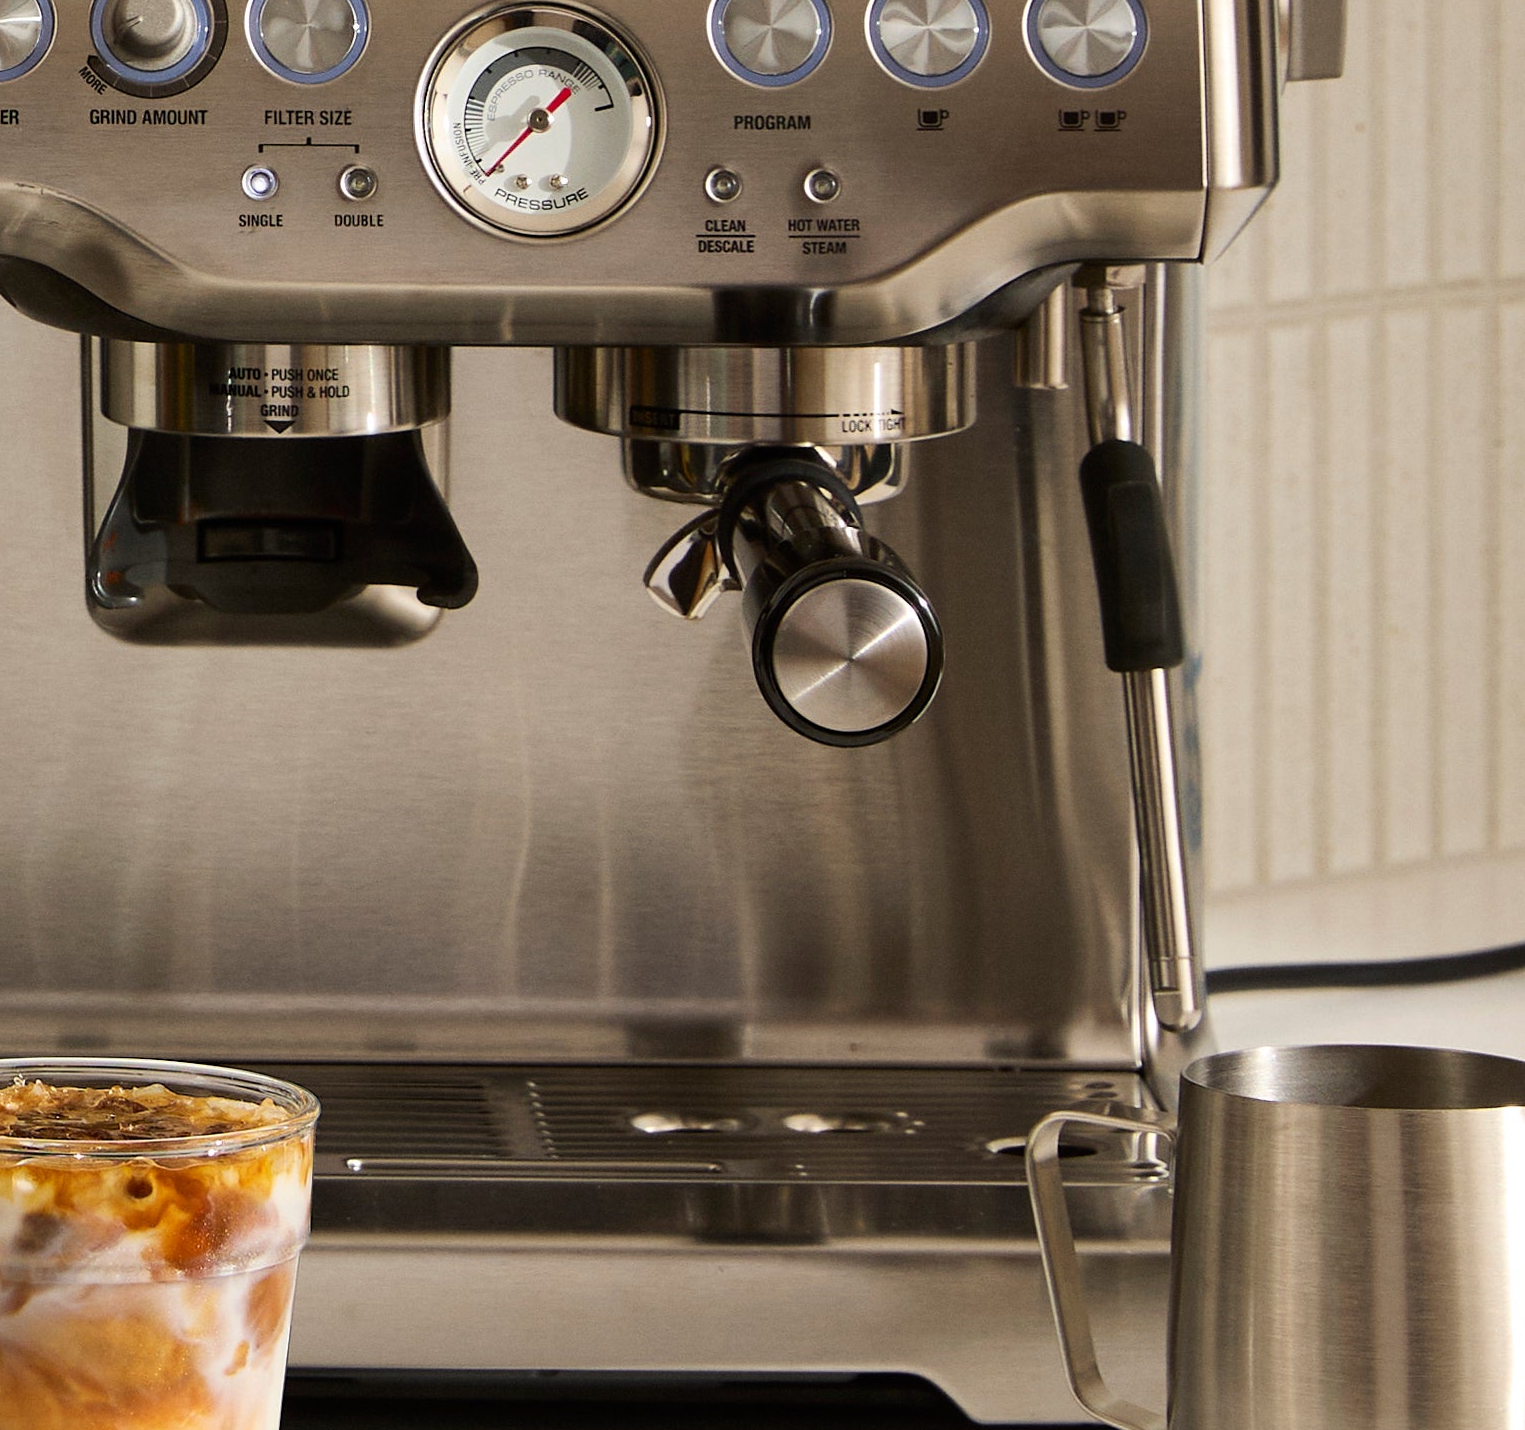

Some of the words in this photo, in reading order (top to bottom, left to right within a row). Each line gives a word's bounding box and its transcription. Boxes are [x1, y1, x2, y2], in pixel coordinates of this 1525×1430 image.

[79, 66, 108, 95] MORE
[487, 69, 533, 121] ESPRESSO
[538, 69, 581, 95] RANGE
[90, 109, 136, 124] GRIND
[142, 110, 208, 125] AMOUNT
[265, 109, 314, 126] FILTER
[319, 109, 352, 126] SIZE
[734, 115, 811, 130] PROGRAM
[495, 187, 589, 210] PRESSURE
[239, 215, 283, 227] SINGLE
[335, 215, 383, 227] DOUBLE
[705, 220, 746, 232] CLEAN
[788, 219, 813, 231] HOT
[816, 219, 860, 231] WATER
[698, 240, 754, 253] DESCALE
[803, 242, 846, 254] STEAM
[229, 368, 260, 380] AUTO
[272, 369, 303, 381] PUSH
[307, 369, 338, 381] ONCE
[272, 385, 303, 398] PUSH
[320, 385, 349, 397] HOLD
[261, 405, 298, 417] GRIND
[842, 420, 872, 432] LOCK
